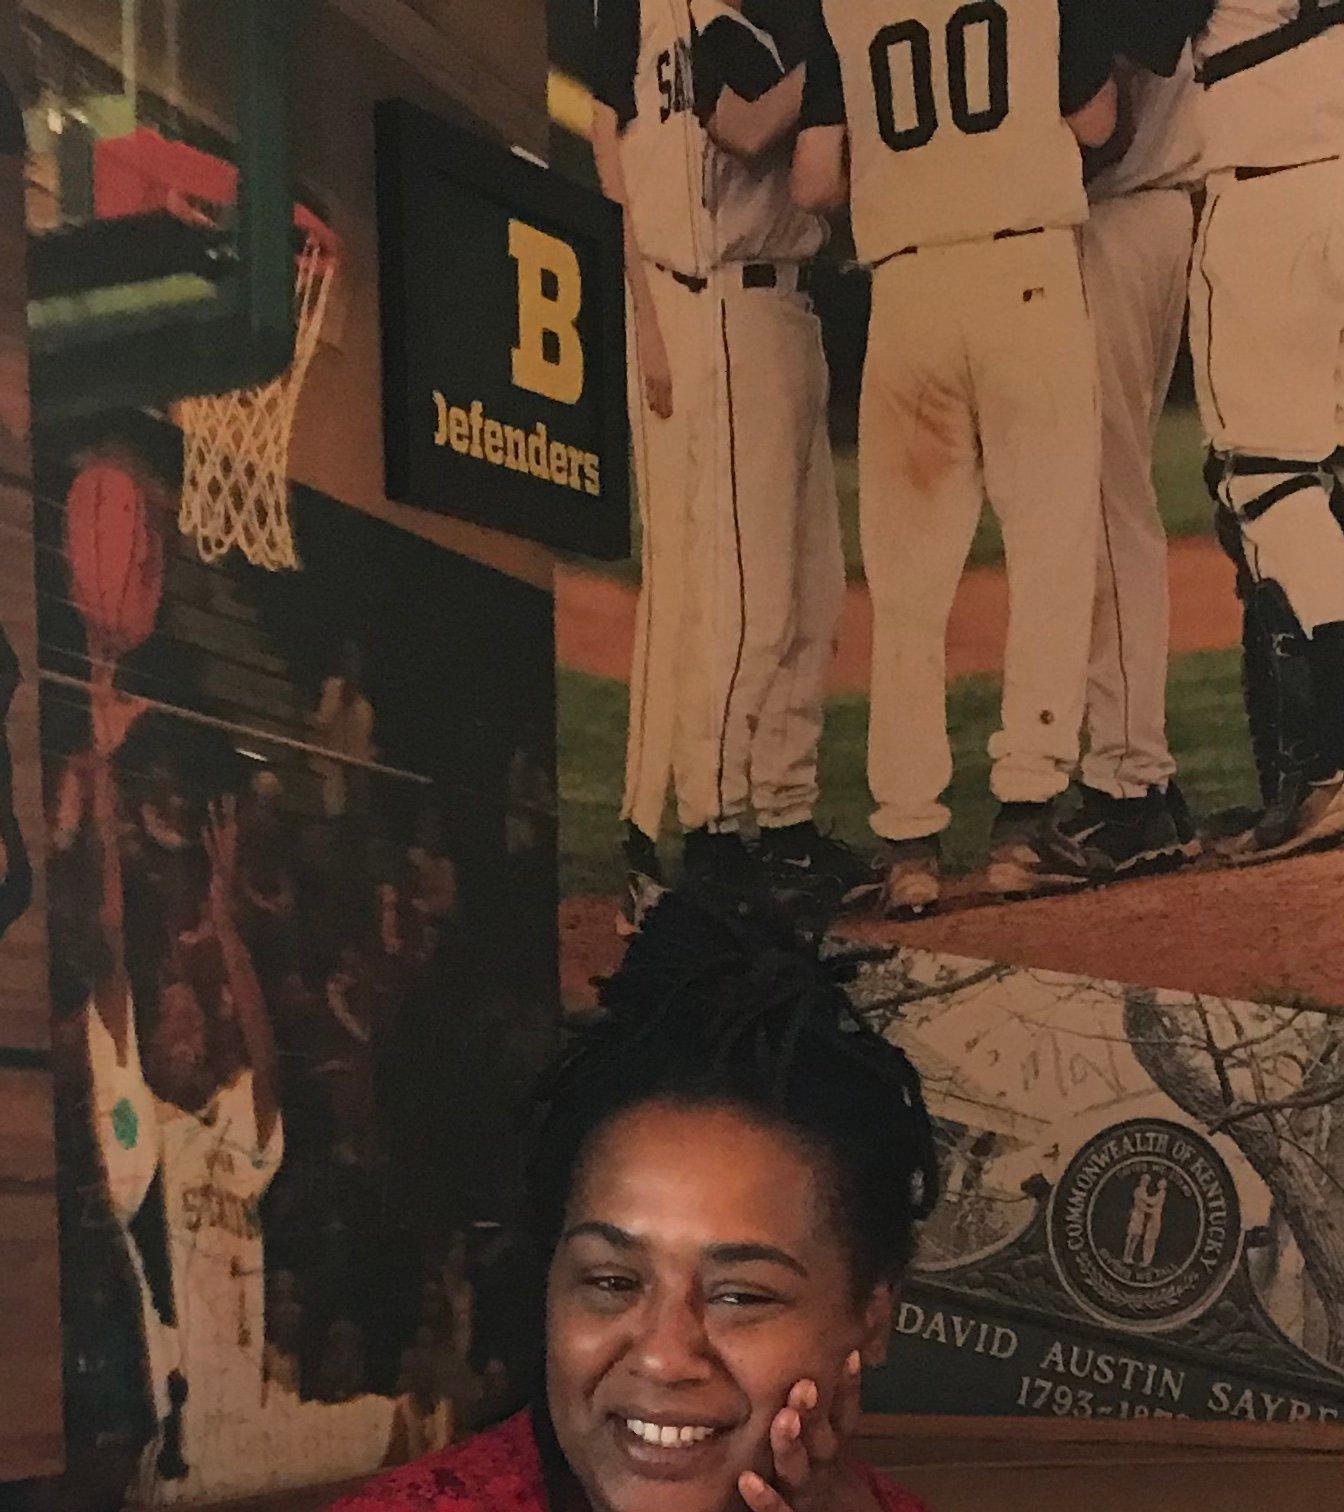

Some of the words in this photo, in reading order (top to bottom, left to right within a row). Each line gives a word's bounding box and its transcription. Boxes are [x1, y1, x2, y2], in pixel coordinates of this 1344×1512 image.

[869, 1, 1009, 152] 00
[508, 219, 584, 405] B
[1065, 1132, 1170, 1250] COMMONWEALTH
[1172, 1141, 1197, 1162] OF
[1192, 1157, 1229, 1275] KENTUCKY
[895, 1302, 1019, 1360] DAVID
[1040, 1341, 1186, 1401] AUSTIN
